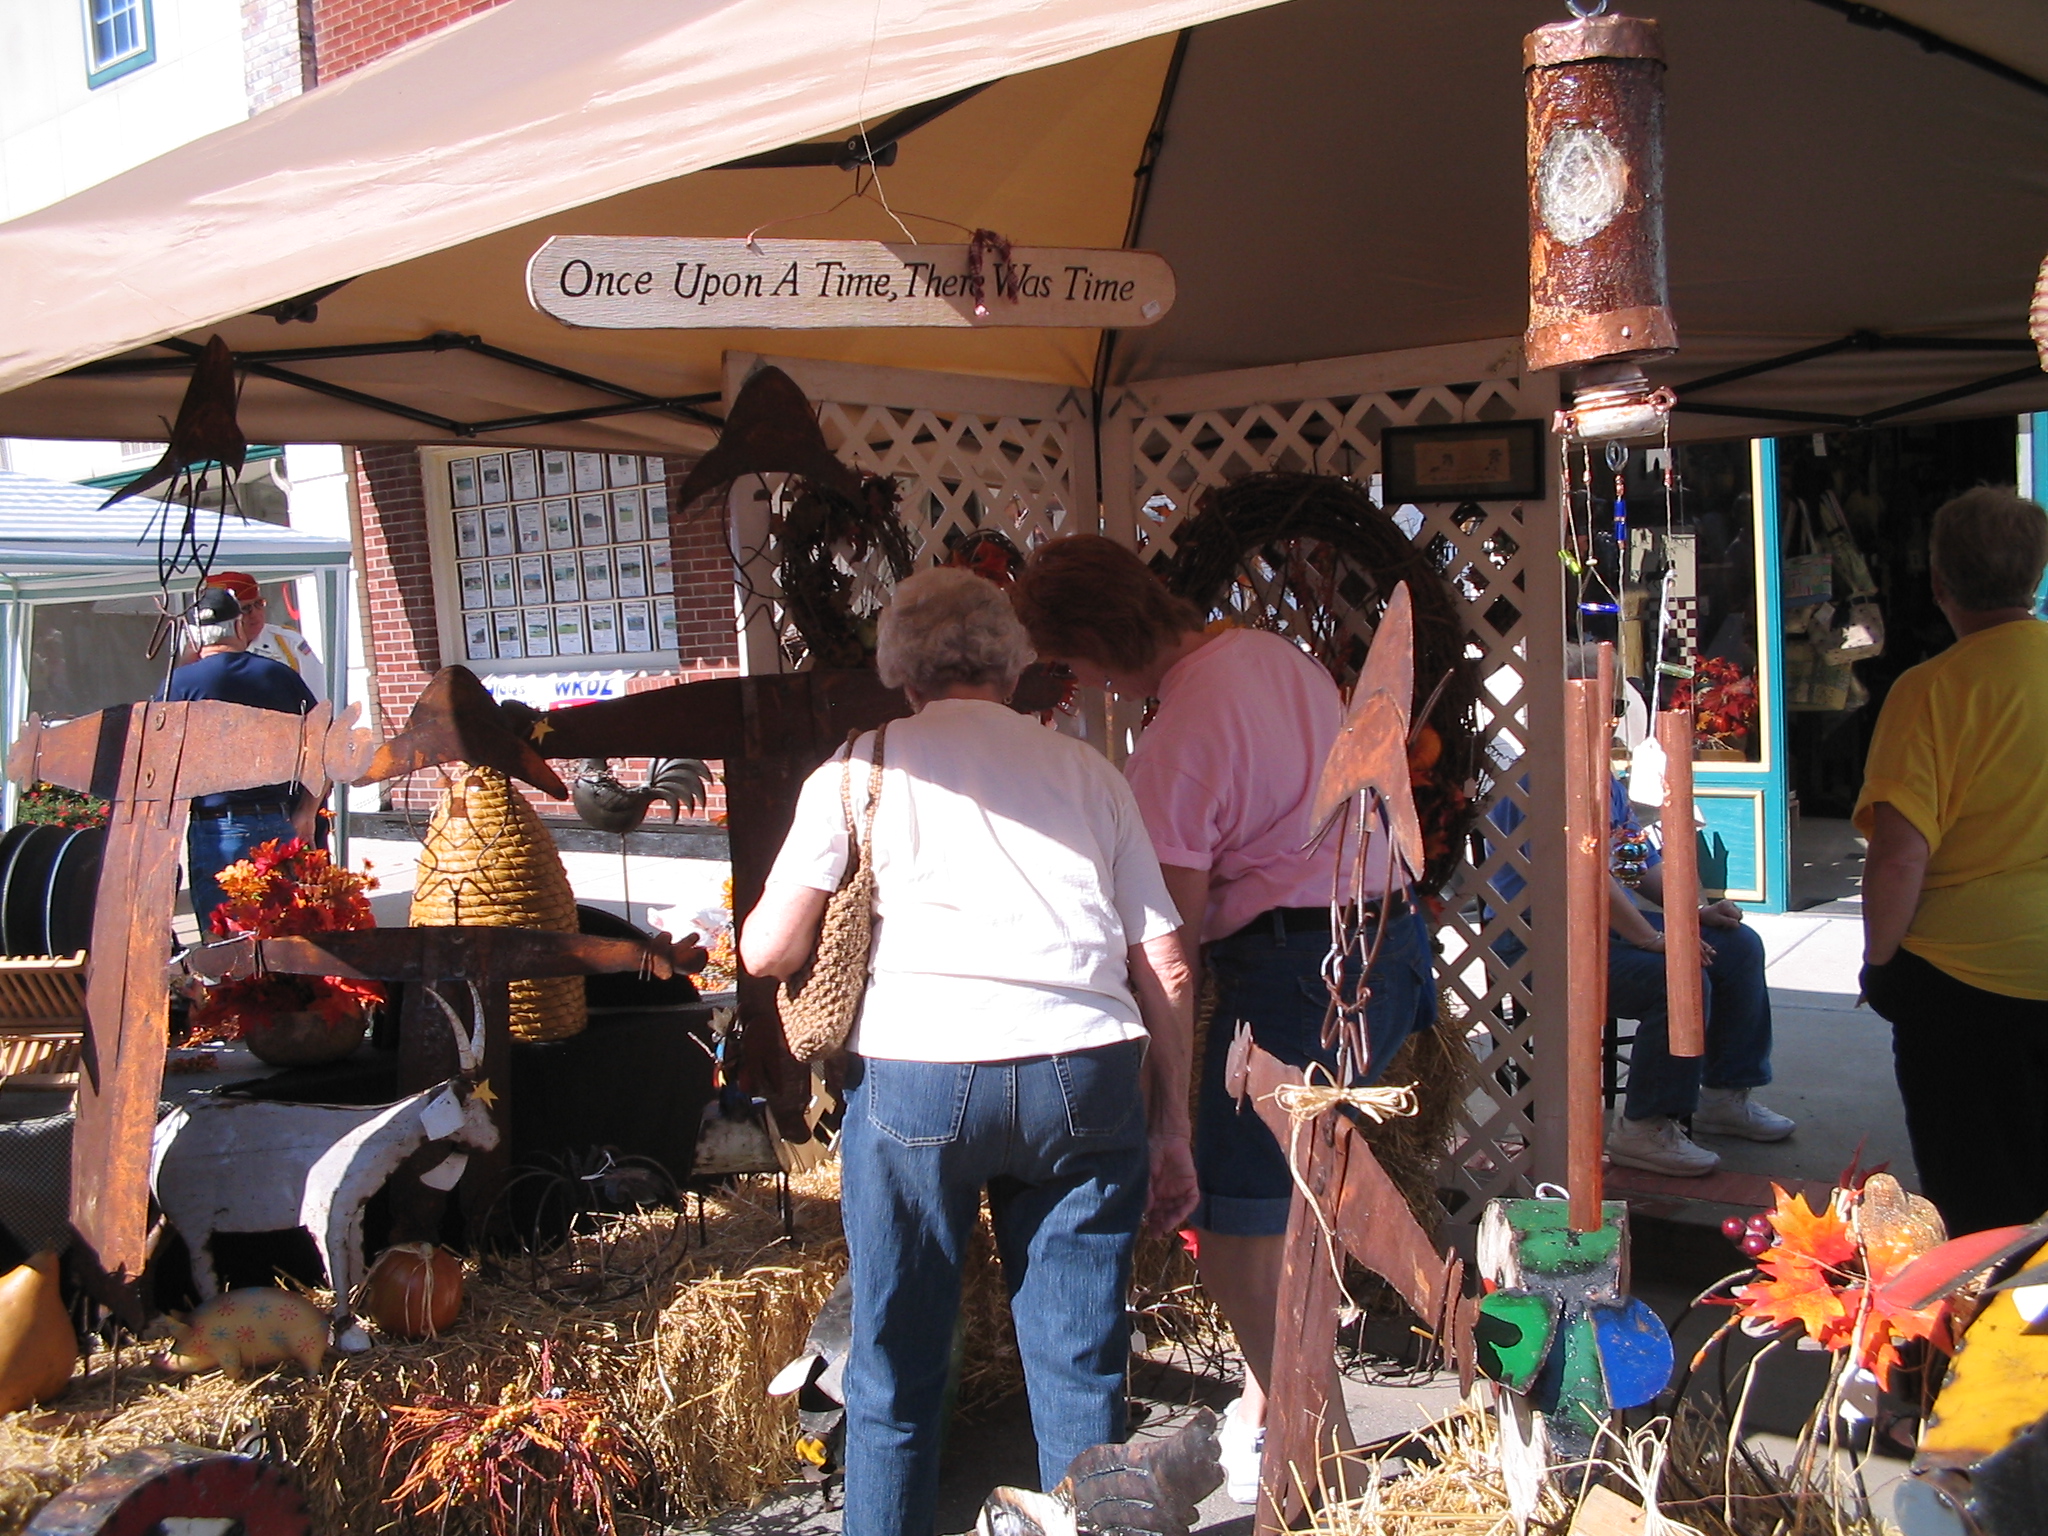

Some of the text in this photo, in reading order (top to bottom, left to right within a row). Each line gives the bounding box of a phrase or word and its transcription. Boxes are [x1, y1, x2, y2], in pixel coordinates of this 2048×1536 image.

[559, 258, 653, 298] Once
[673, 261, 763, 306] Upon
[769, 260, 799, 297] A
[815, 261, 899, 302] Time,
[992, 263, 1054, 298] Was
[1064, 266, 1136, 302] Time
